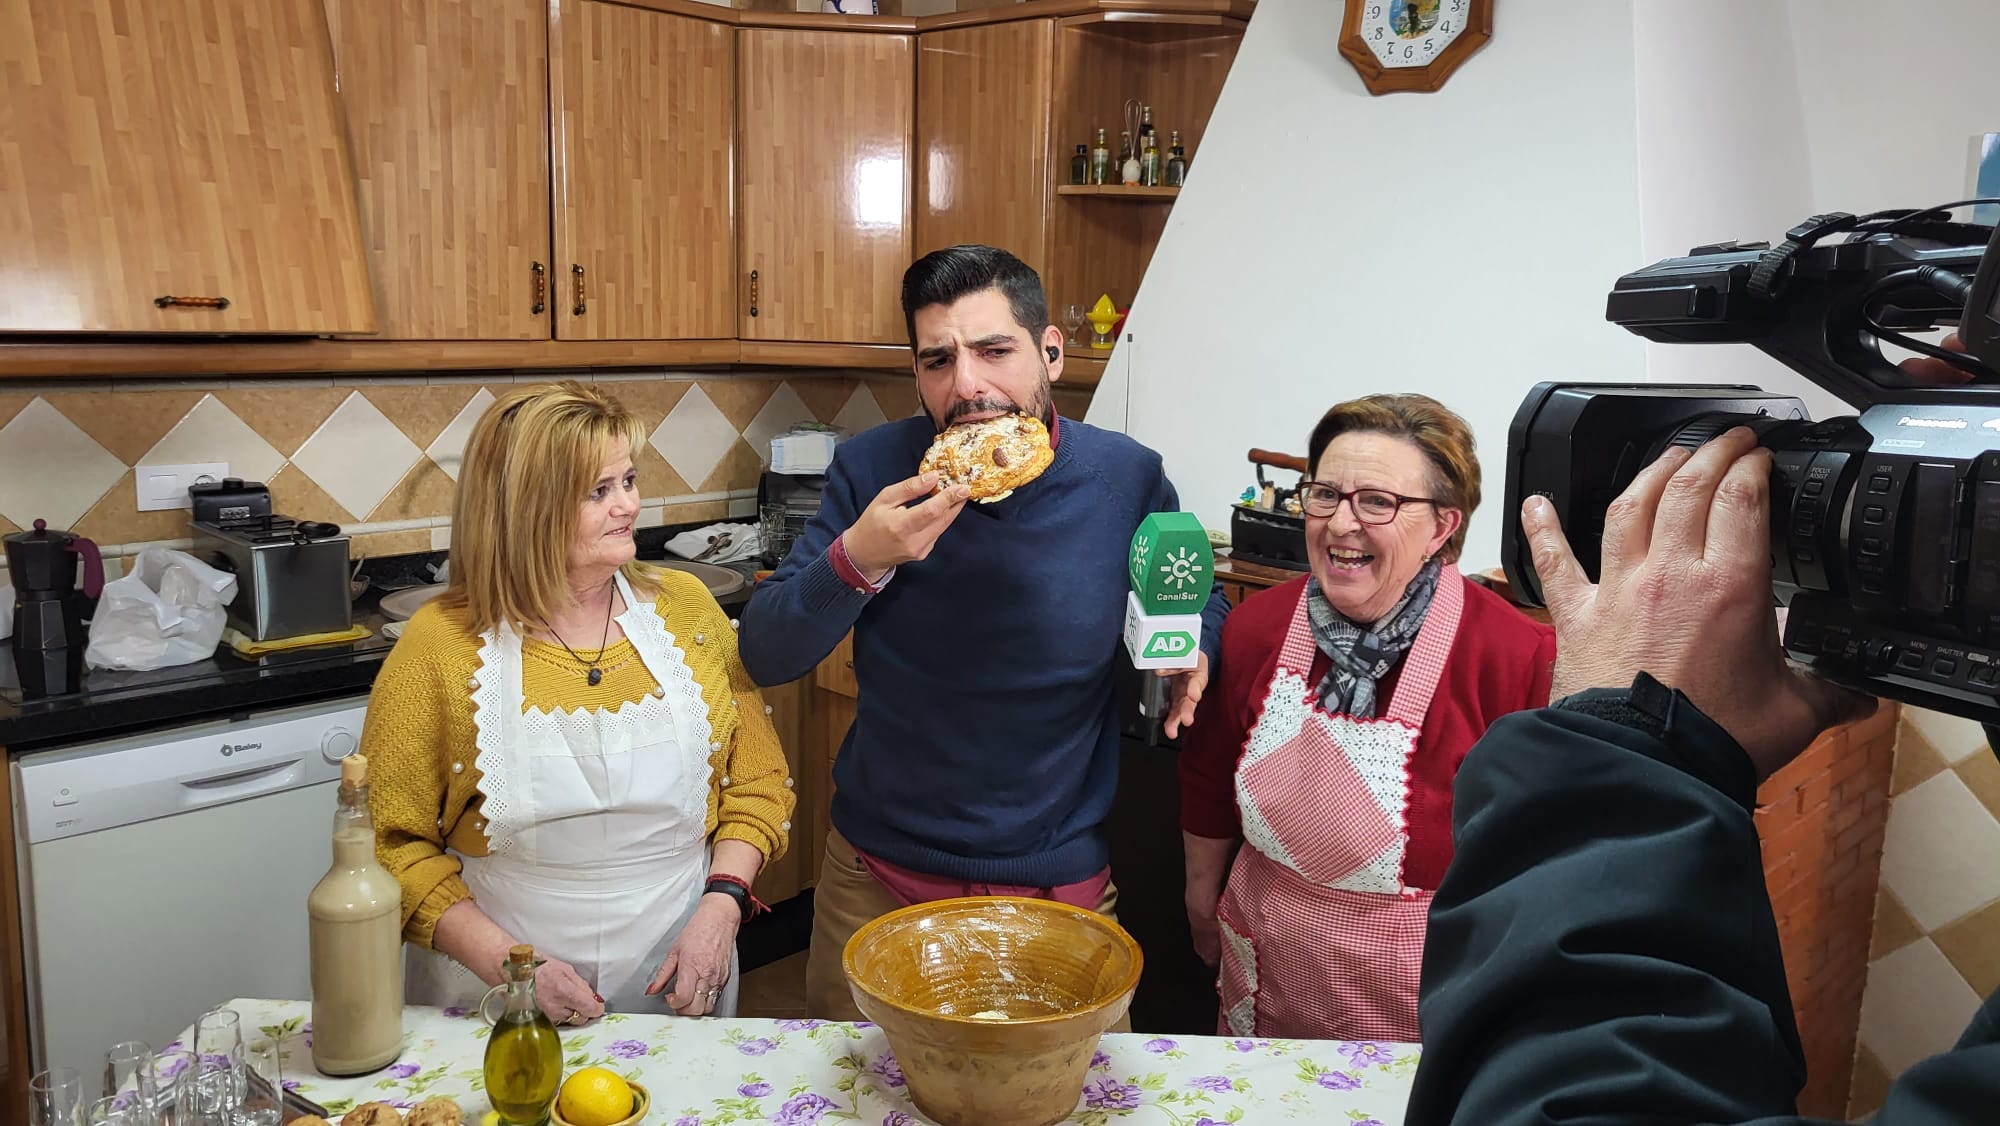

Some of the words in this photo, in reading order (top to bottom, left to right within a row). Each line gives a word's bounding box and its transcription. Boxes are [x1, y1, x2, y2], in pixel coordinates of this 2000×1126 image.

[1372, 6, 1381, 19] 9
[1451, 0, 1460, 12] 3
[1440, 20, 1450, 33] 4
[1374, 27, 1384, 40] 8
[1387, 41, 1396, 55] 7
[1423, 38, 1433, 51] 5
[1404, 45, 1413, 59] 6
[1156, 591, 1199, 601] CanalSur
[1151, 636, 1187, 652] AD
[1909, 641, 1929, 650] MENU
[1937, 646, 1965, 658] SHUTTER
